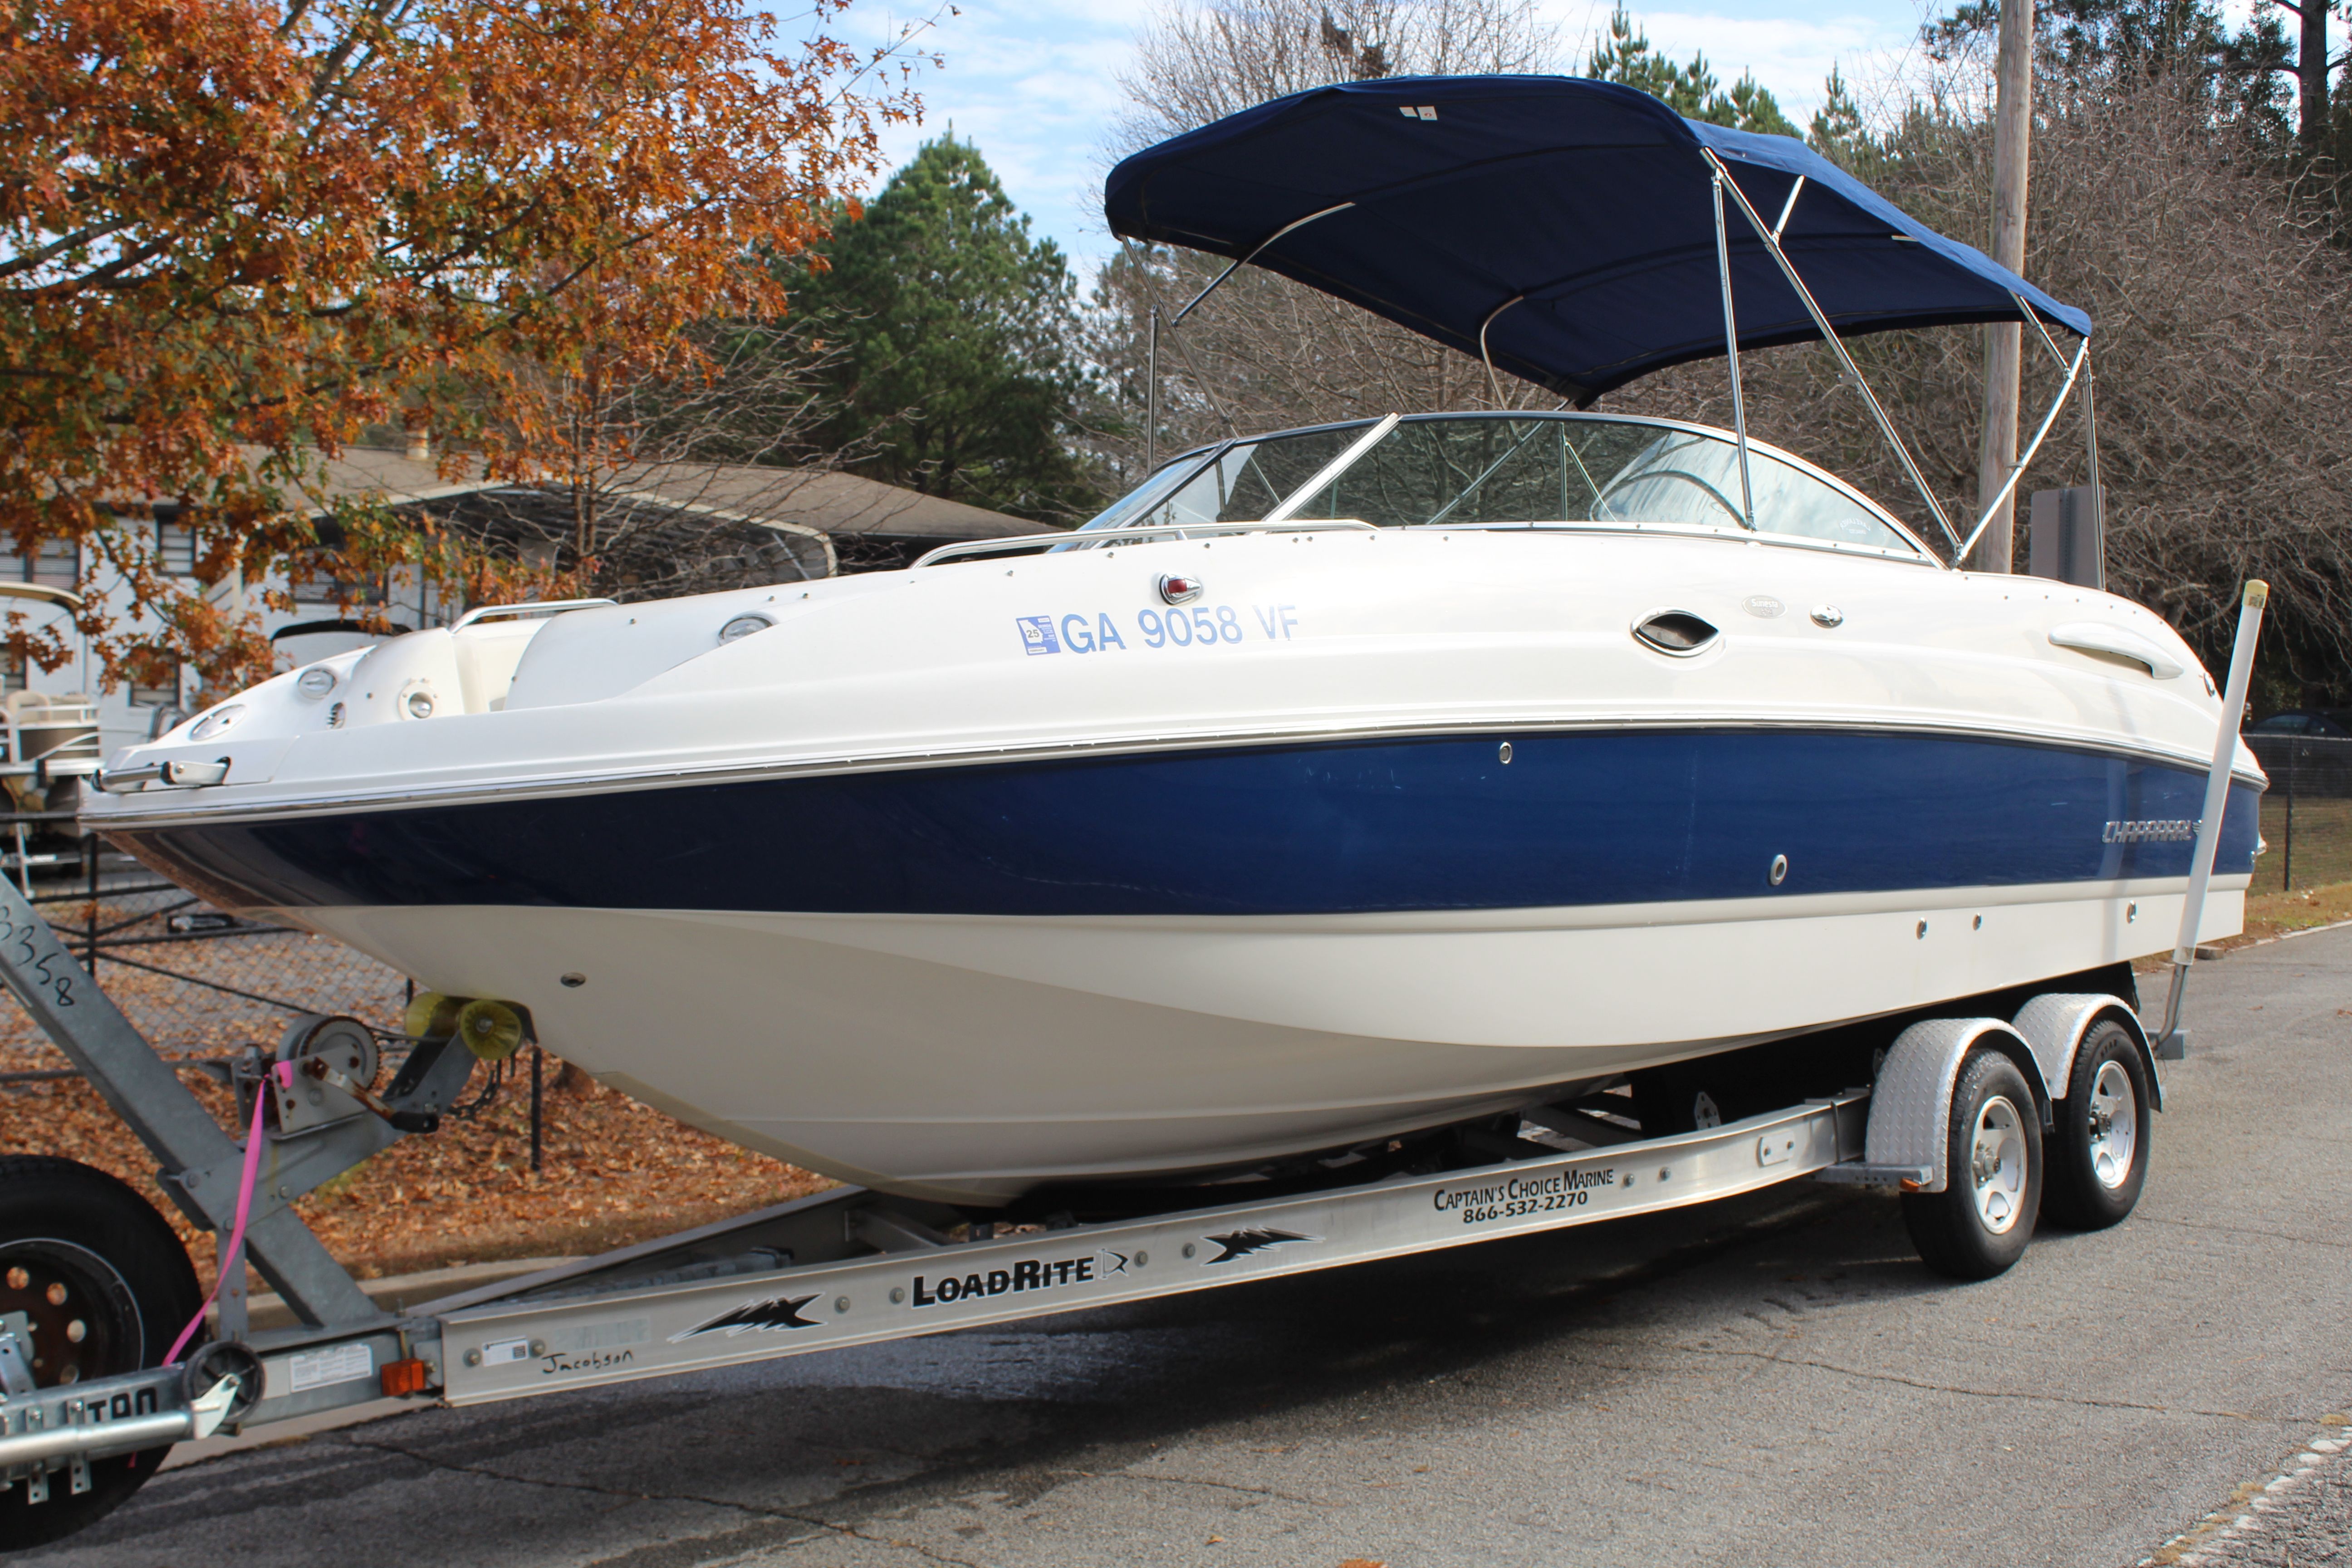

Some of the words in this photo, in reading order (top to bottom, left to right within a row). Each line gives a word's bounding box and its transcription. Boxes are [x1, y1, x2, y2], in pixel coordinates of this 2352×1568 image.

[1751, 598, 1778, 608] Sunesta
[1026, 629, 1039, 638] 25
[1061, 612, 1127, 654] GA
[1137, 605, 1243, 648] 9058
[1251, 604, 1298, 640] VF
[2102, 819, 2192, 843] CHAPARRAL
[1434, 1186, 1504, 1211] CAPTAIN'S
[1508, 1178, 1560, 1200] CHOICE
[1563, 1169, 1614, 1191] MARINE
[1463, 1191, 1588, 1224] 866-532-2270
[541, 1350, 633, 1374] Jacobson
